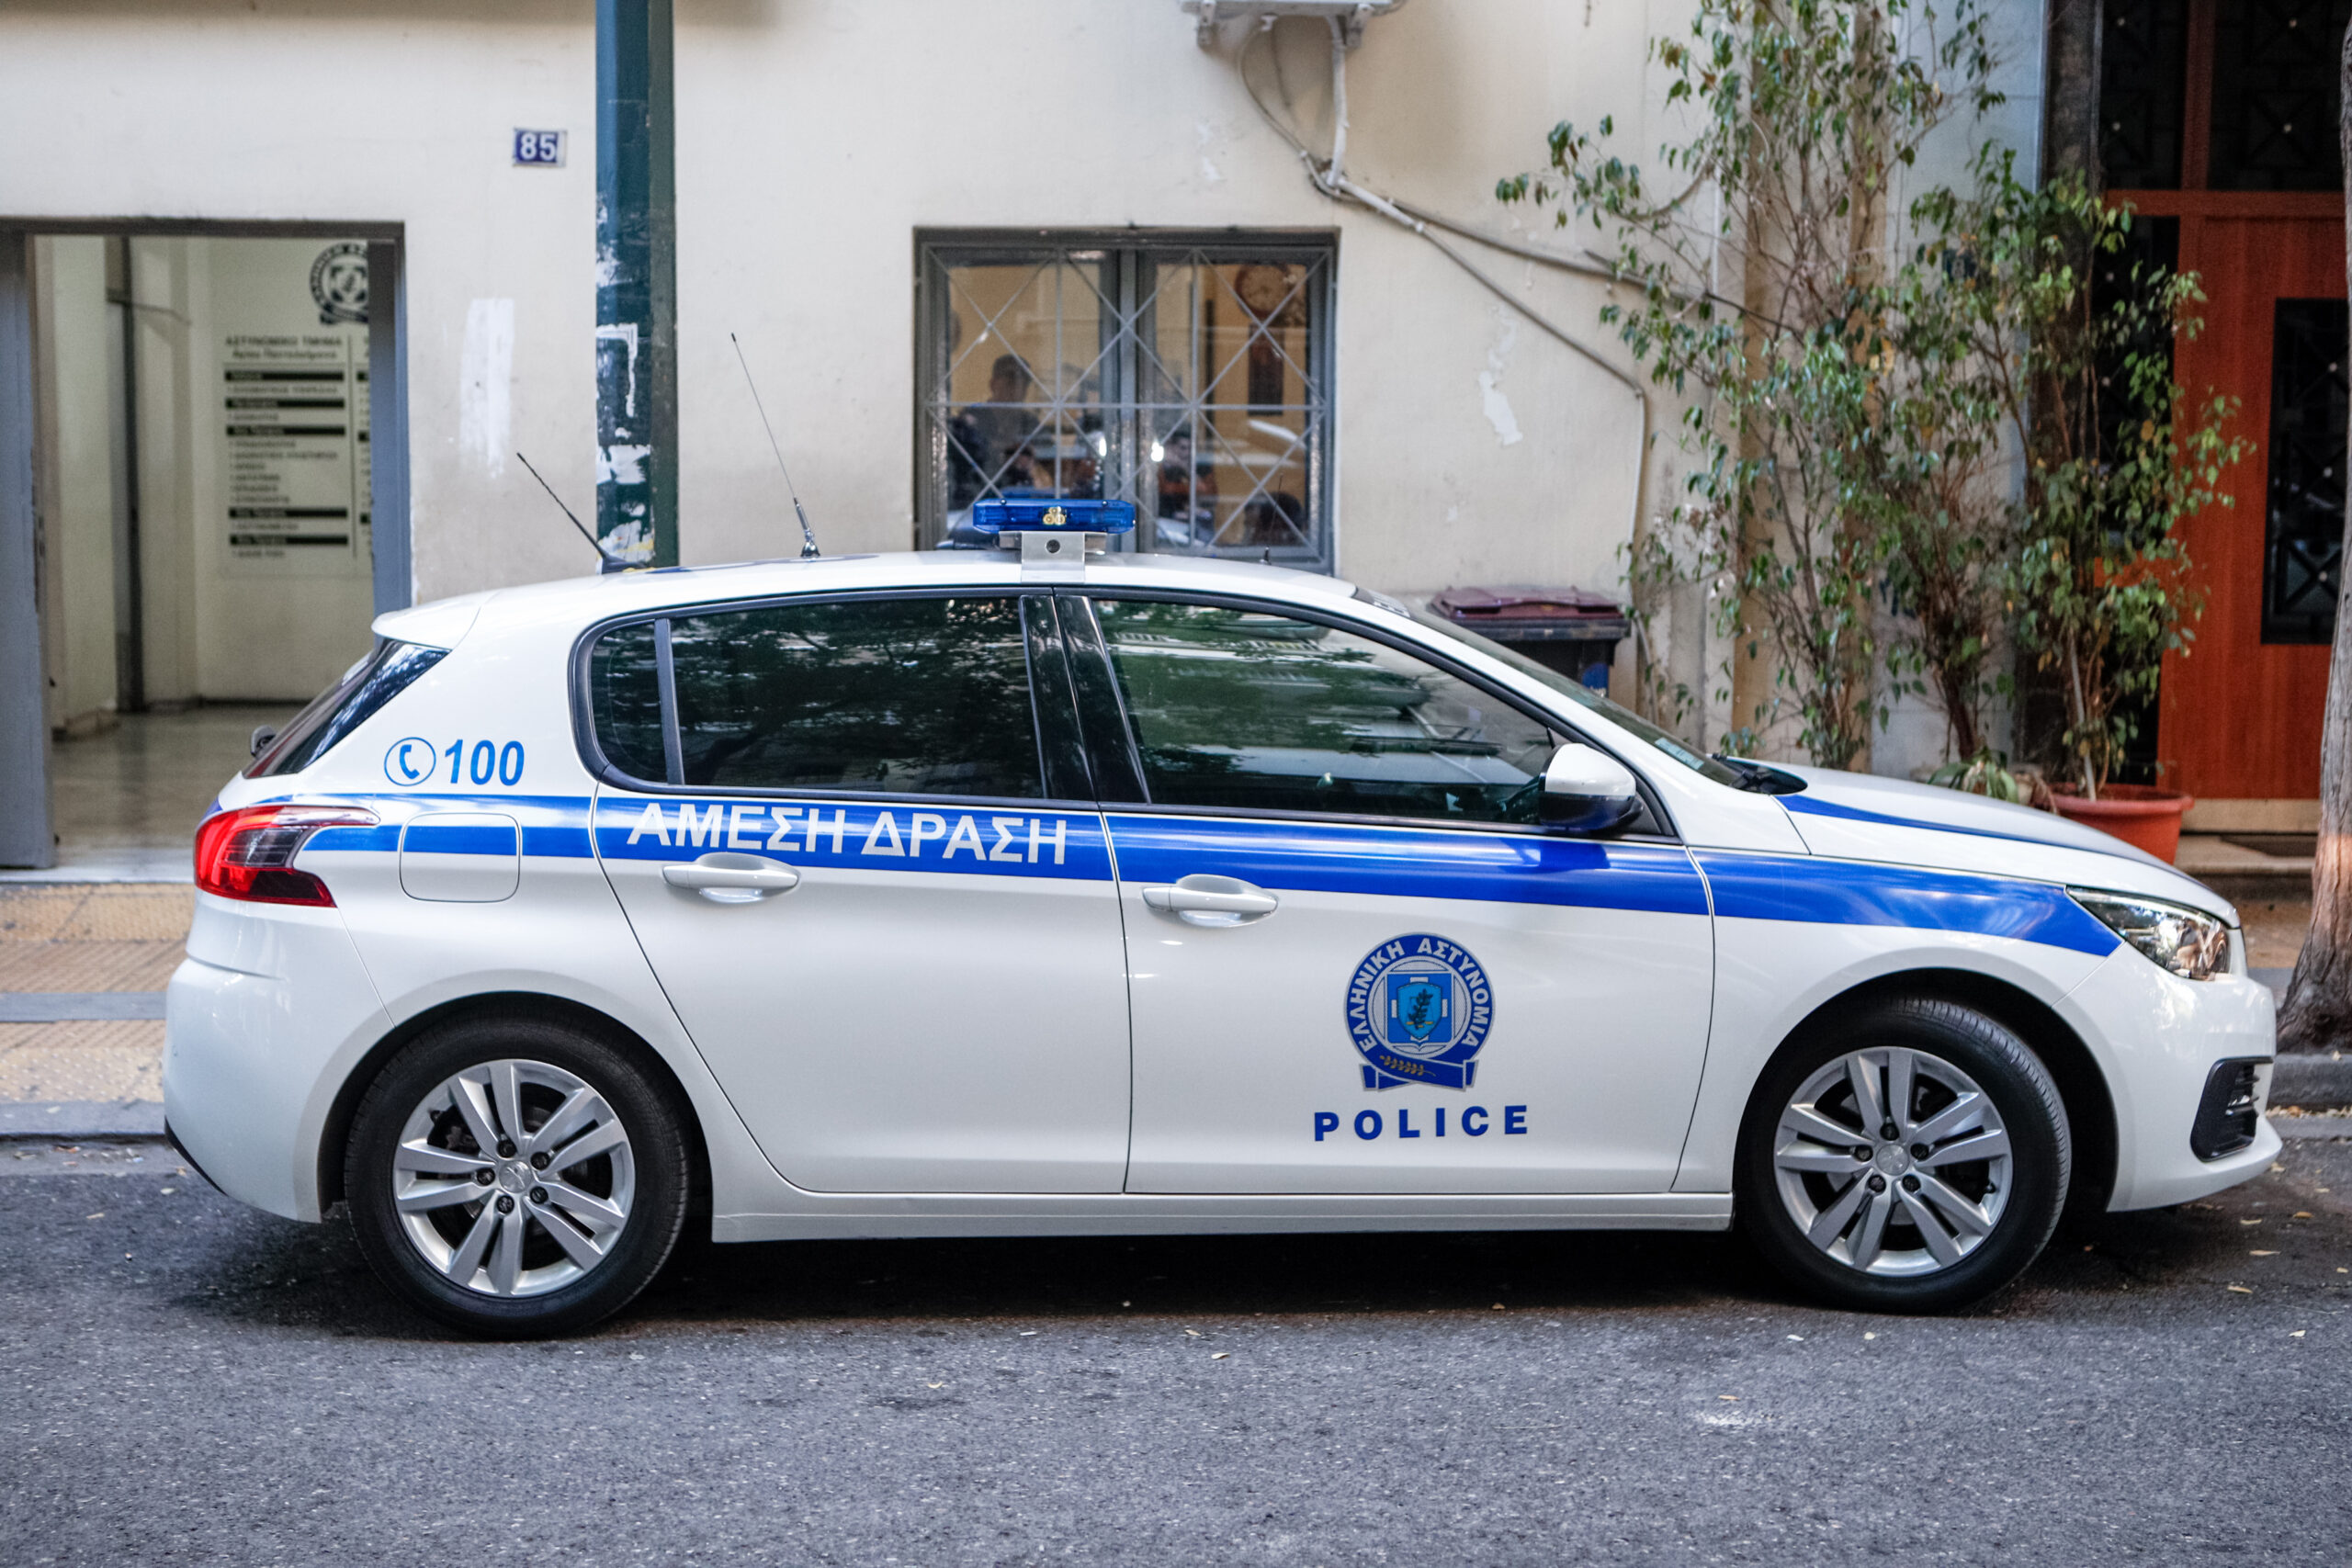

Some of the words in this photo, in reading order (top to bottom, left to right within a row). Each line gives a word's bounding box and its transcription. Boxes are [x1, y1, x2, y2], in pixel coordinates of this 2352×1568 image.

[520, 132, 556, 161] 85
[444, 739, 525, 786] 100
[627, 802, 845, 853] ΑΜΕΣΗ
[861, 811, 1067, 865] ΔΡΑΣΗ
[1350, 941, 1406, 1053] ΕΛΛΗΝΙΚΗ
[1417, 938, 1490, 1047] ΑΣΤΥΝΟΜΙΑ
[1314, 1105, 1528, 1142] POLICE
